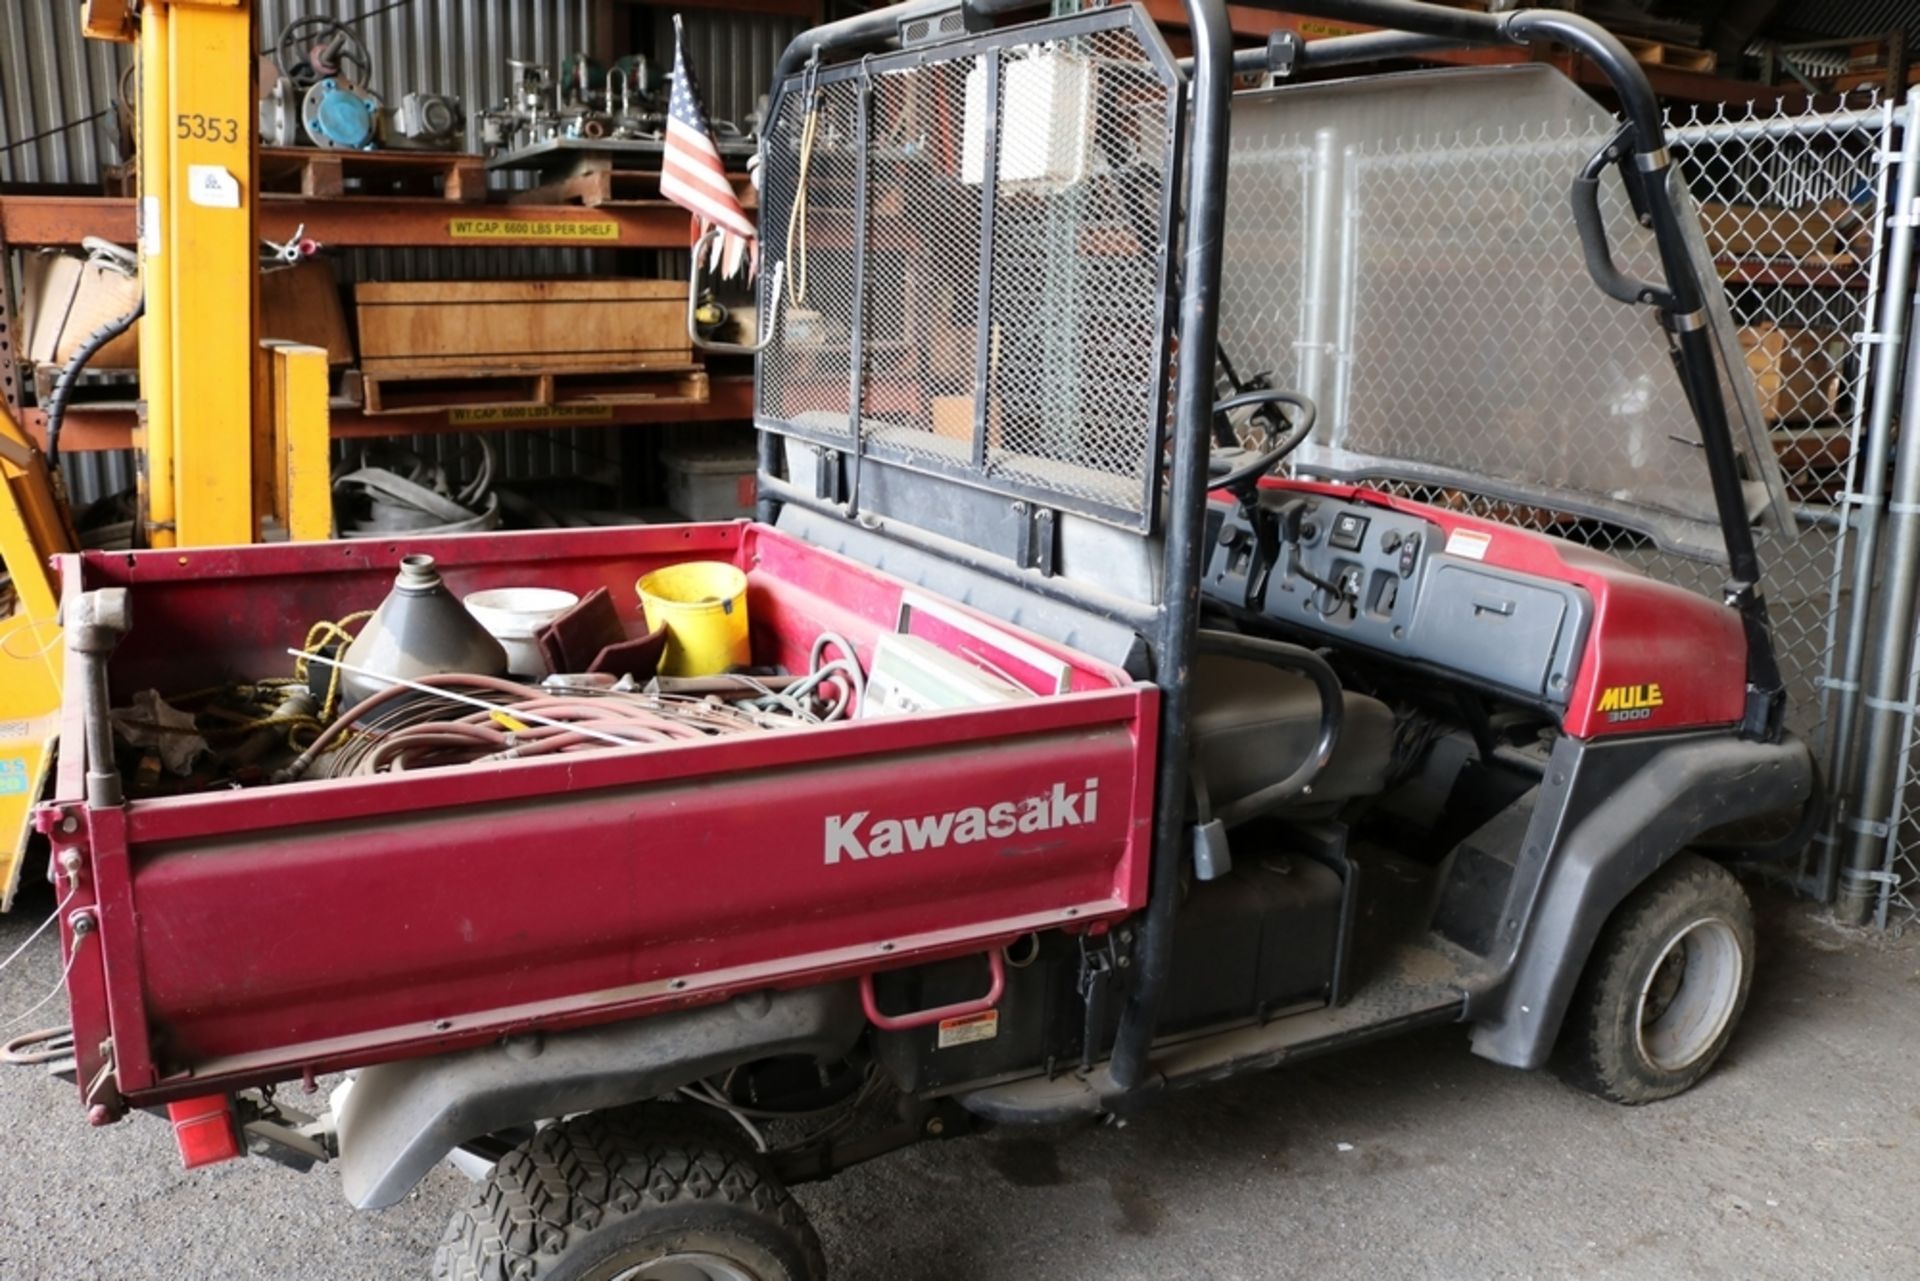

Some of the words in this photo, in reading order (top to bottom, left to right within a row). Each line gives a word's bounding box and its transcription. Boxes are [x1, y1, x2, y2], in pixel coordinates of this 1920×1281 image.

[177, 113, 238, 143] 5353
[505, 222, 528, 234] 6600
[531, 223, 552, 235] LBS
[555, 224, 576, 235] PER
[579, 224, 612, 236] SHELF
[1596, 683, 1664, 711] MULE
[1607, 708, 1651, 723] 3000
[824, 777, 1099, 865] Kawasaki
